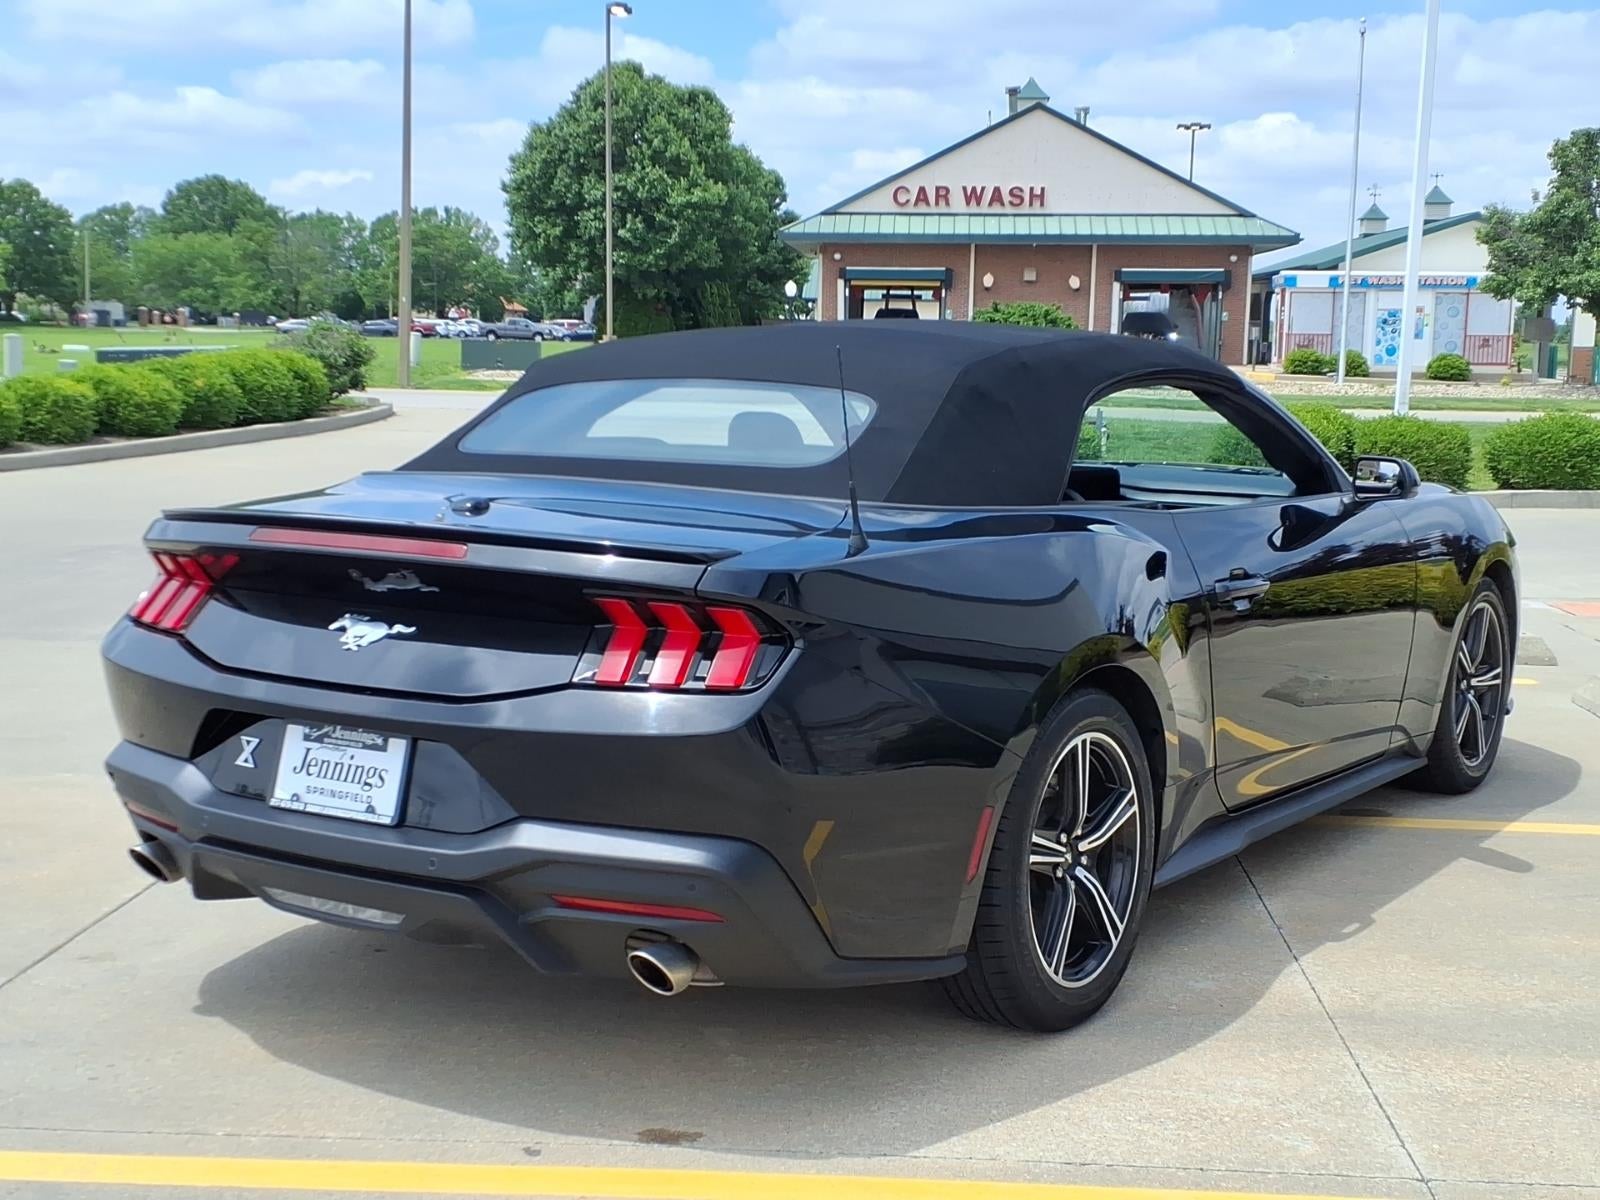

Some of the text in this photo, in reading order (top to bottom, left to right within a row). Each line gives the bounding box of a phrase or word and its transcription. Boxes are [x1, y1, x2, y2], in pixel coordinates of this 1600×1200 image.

[892, 185, 1046, 208] CAR WASH
[293, 746, 389, 792] Jennings
[305, 784, 374, 805] SPRINGFIELD
